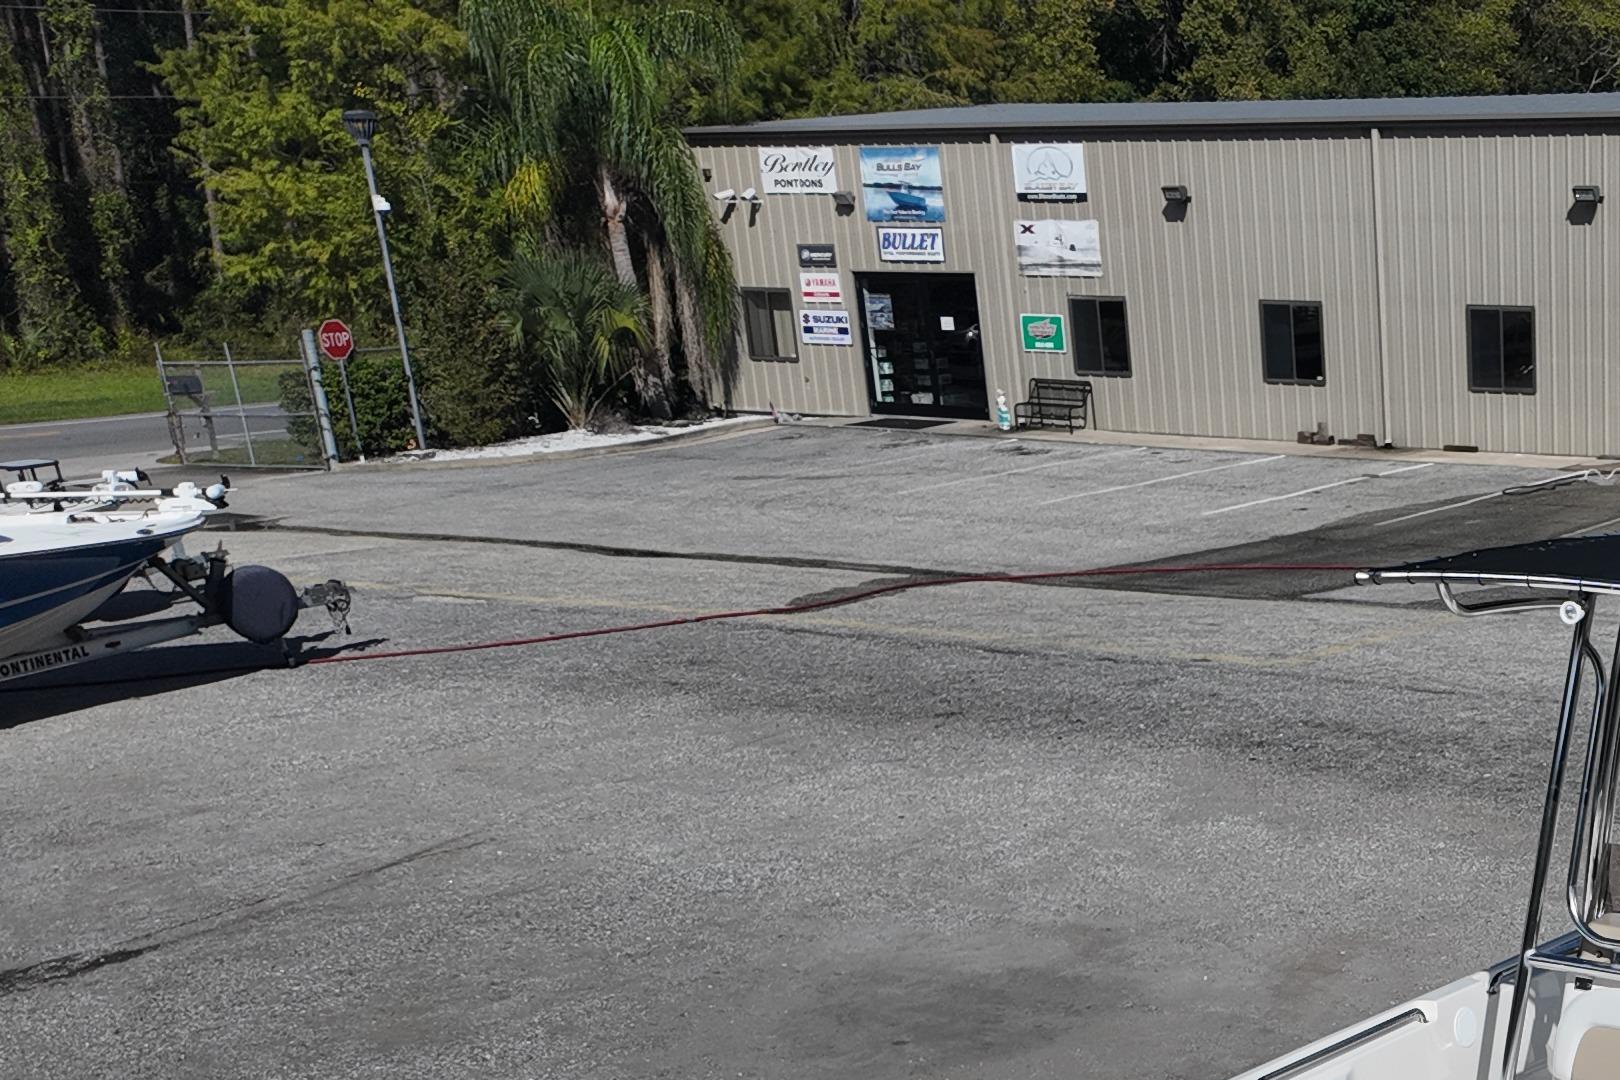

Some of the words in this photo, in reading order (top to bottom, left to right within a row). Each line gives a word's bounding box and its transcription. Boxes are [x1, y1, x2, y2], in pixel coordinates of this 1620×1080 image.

[761, 153, 834, 177] Bentley
[774, 179, 823, 188] PONTOONS
[882, 232, 939, 251] BULLET
[812, 278, 836, 287] YAMAHA
[812, 315, 848, 324] SUZUKI
[322, 331, 349, 348] STOP
